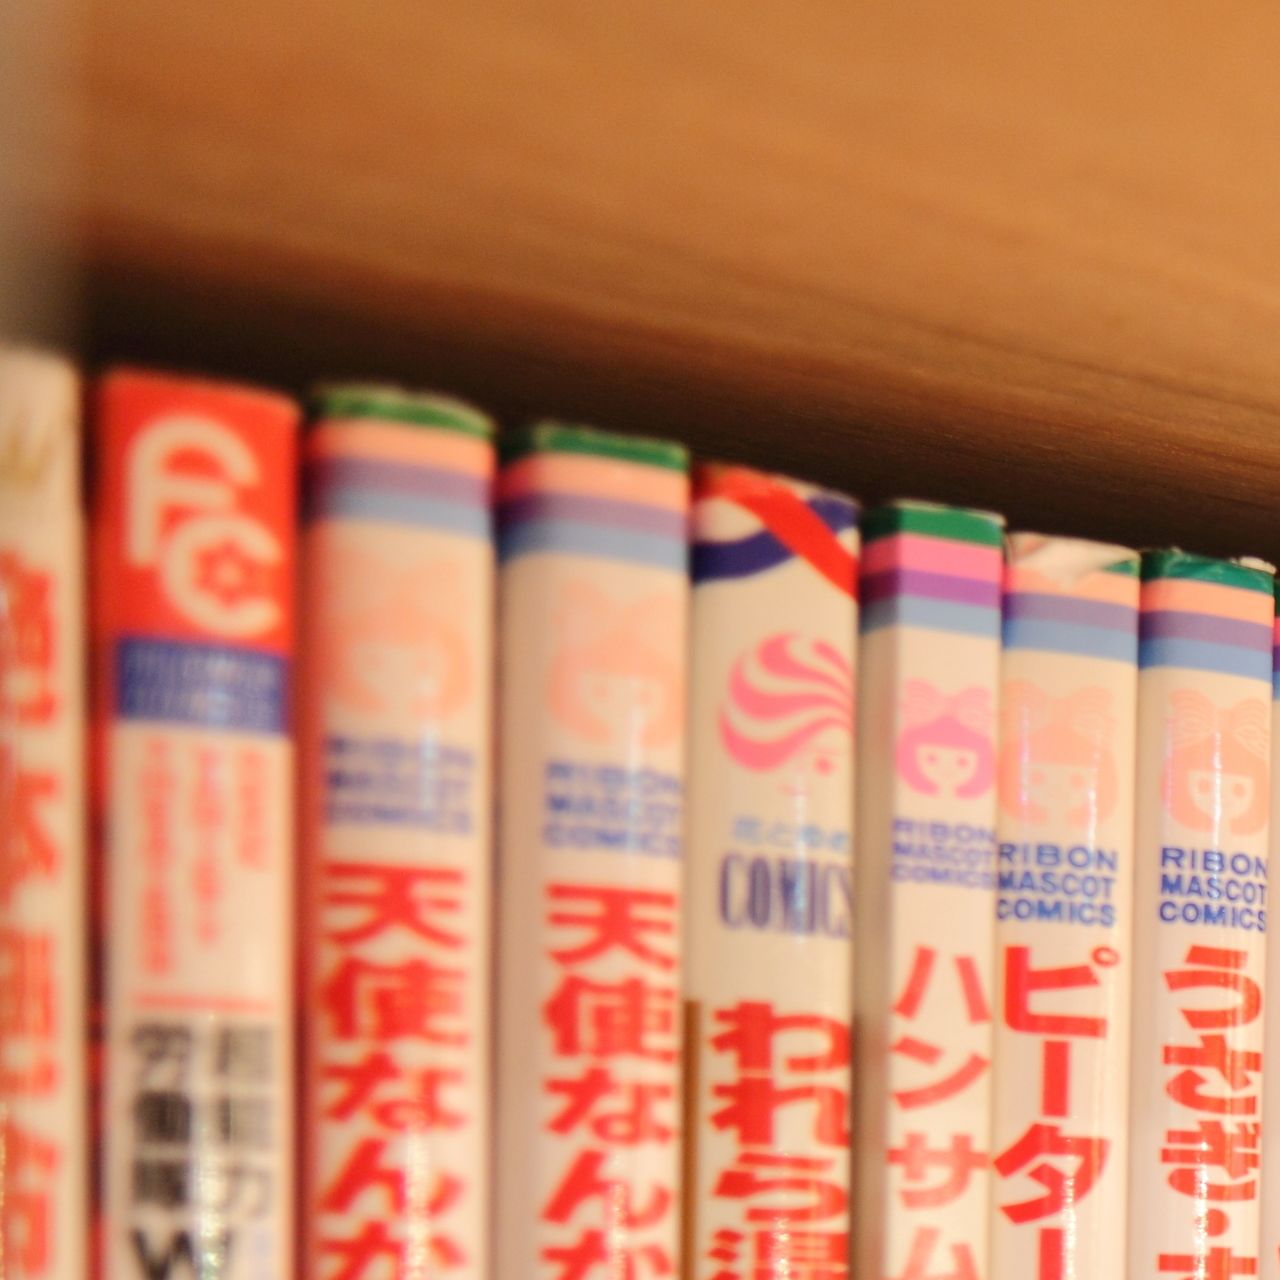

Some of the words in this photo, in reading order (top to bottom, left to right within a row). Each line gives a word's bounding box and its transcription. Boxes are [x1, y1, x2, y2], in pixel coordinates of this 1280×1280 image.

[997, 842, 1118, 872] RIBON
[1161, 847, 1269, 878] RIBON
[996, 871, 1117, 900] MASCOT
[1160, 873, 1267, 905] MASCOT
[994, 897, 1117, 928] COMICS
[1159, 901, 1267, 933] COMICS
